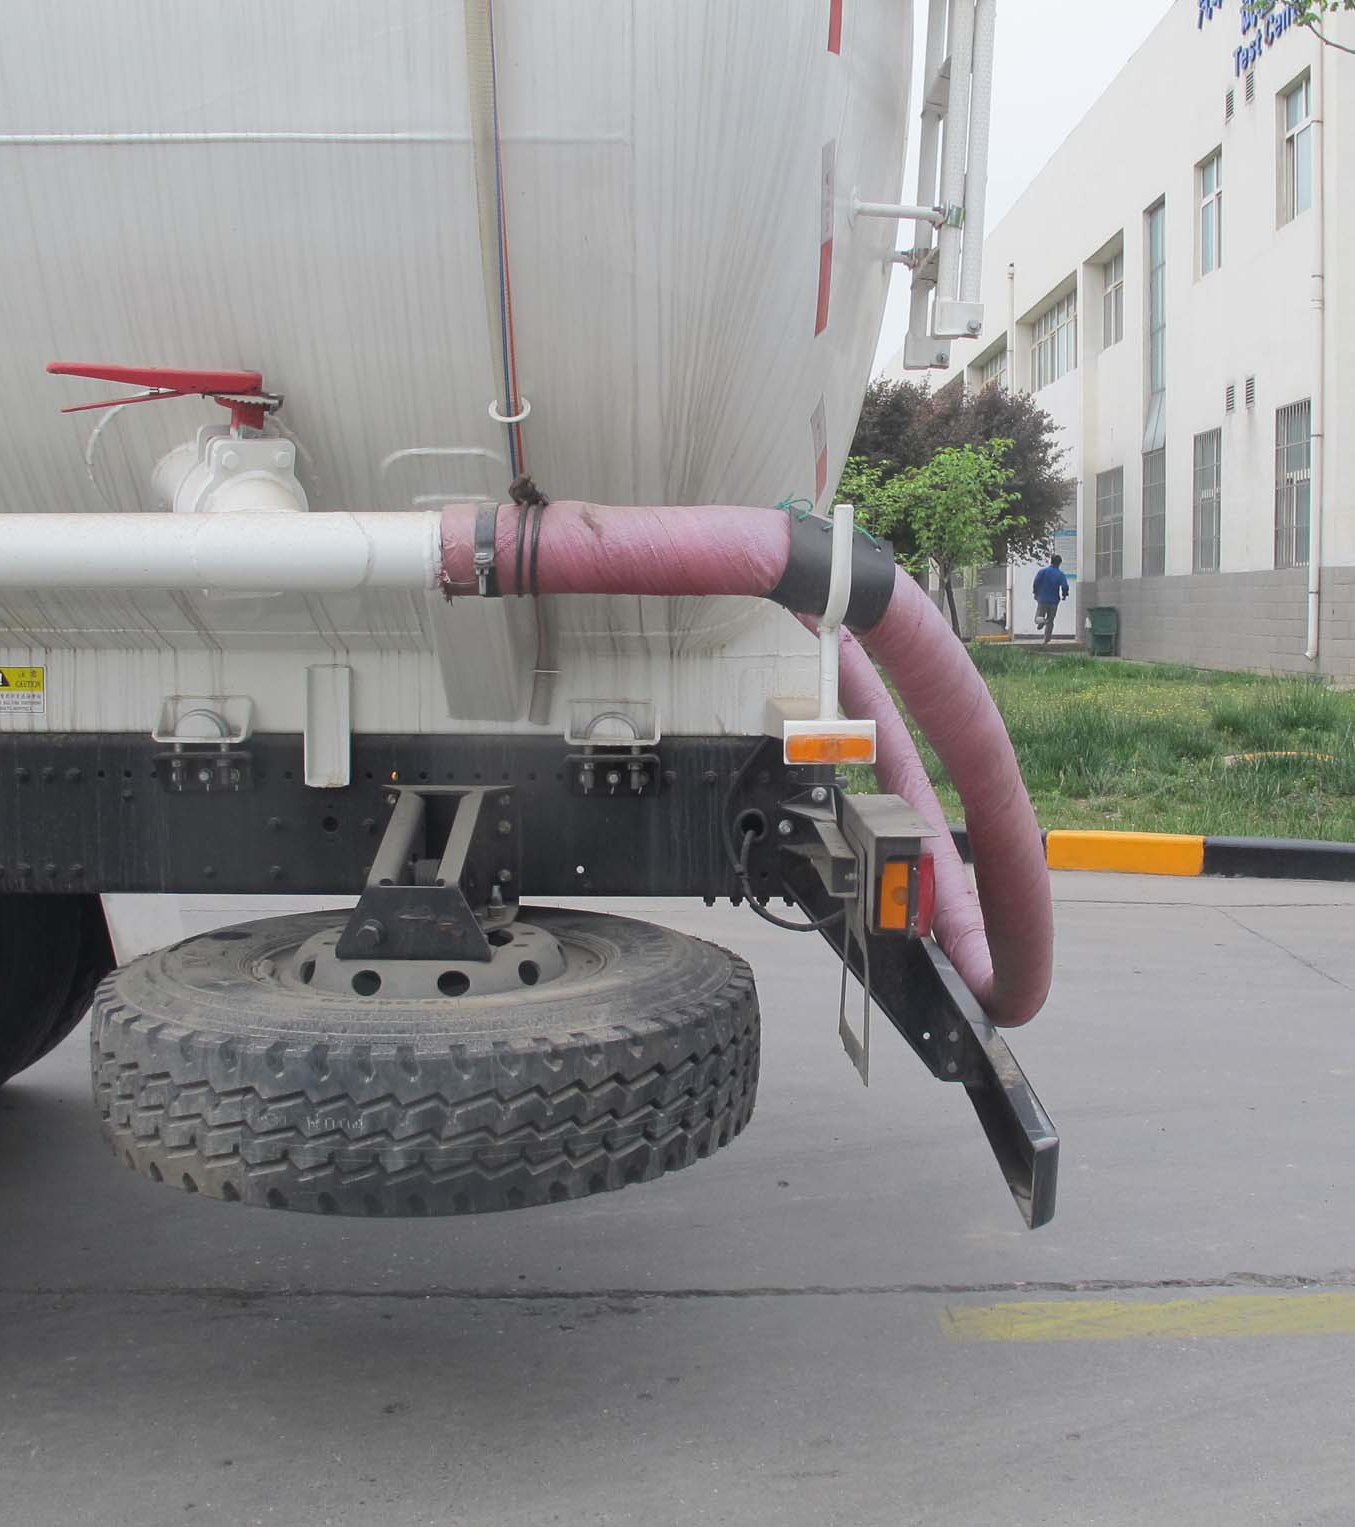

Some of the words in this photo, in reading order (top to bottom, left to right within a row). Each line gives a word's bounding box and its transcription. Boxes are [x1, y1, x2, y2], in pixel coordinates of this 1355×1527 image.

[1233, 28, 1262, 77] Test
[1263, 5, 1297, 46] Cen
[15, 680, 41, 689] CAUTION
